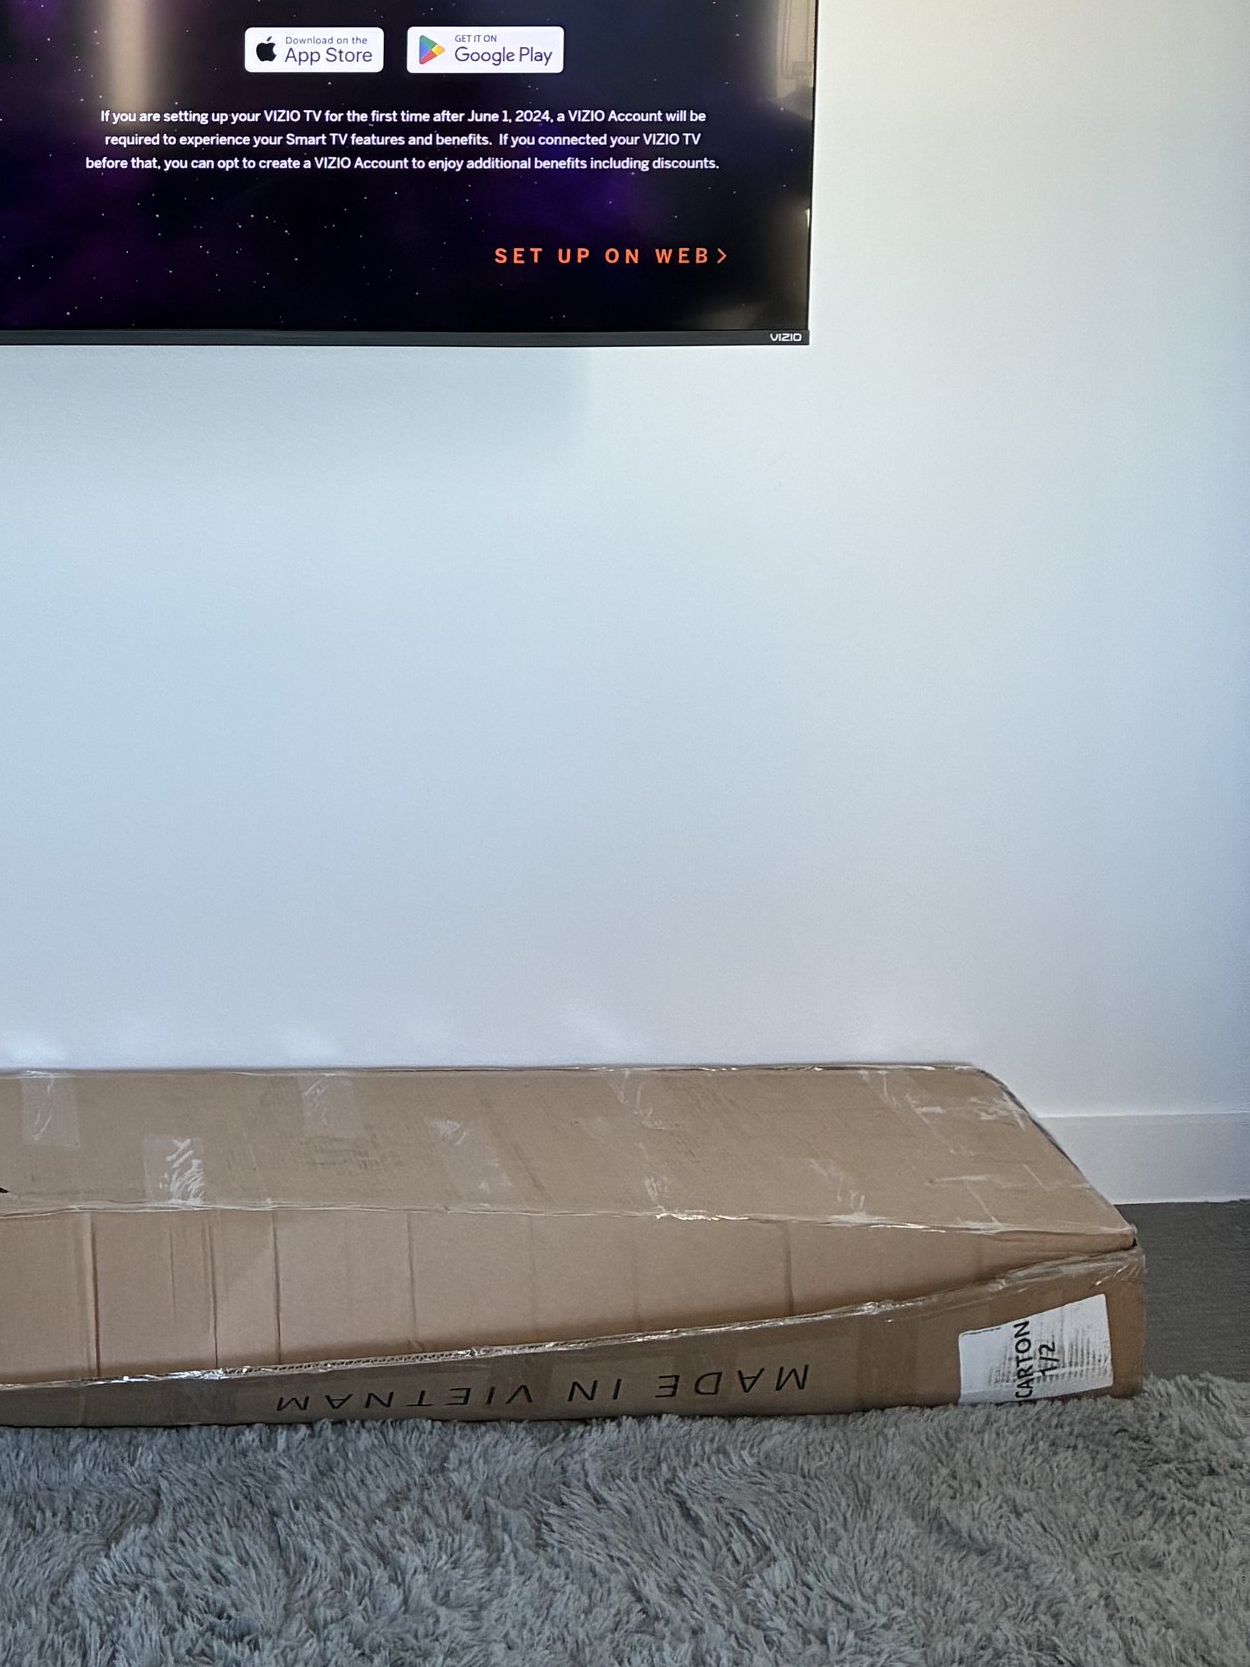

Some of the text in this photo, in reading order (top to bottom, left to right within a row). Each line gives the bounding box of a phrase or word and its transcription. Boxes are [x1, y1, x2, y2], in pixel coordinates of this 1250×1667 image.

[285, 47, 372, 65] App Store
[455, 46, 552, 66] Google Play
[101, 110, 706, 124] If you are setting up your VIZIO TV for the first time after June 1, 2024, a VIZIO Account will be
[105, 132, 701, 148] required to experience your Smart TV features and benefits. If you connected your VIZIO TV
[86, 157, 719, 171] before that, you can opt to create a VIZIO Account to enjoy additional benefits including discounts.
[495, 248, 707, 264] SET UP ON WEB
[770, 333, 802, 341] VIZIO
[1014, 1320, 1033, 1400] CARTON
[1040, 1341, 1060, 1376] 1/2
[277, 1364, 809, 1411] MADE IN VIETNAM
